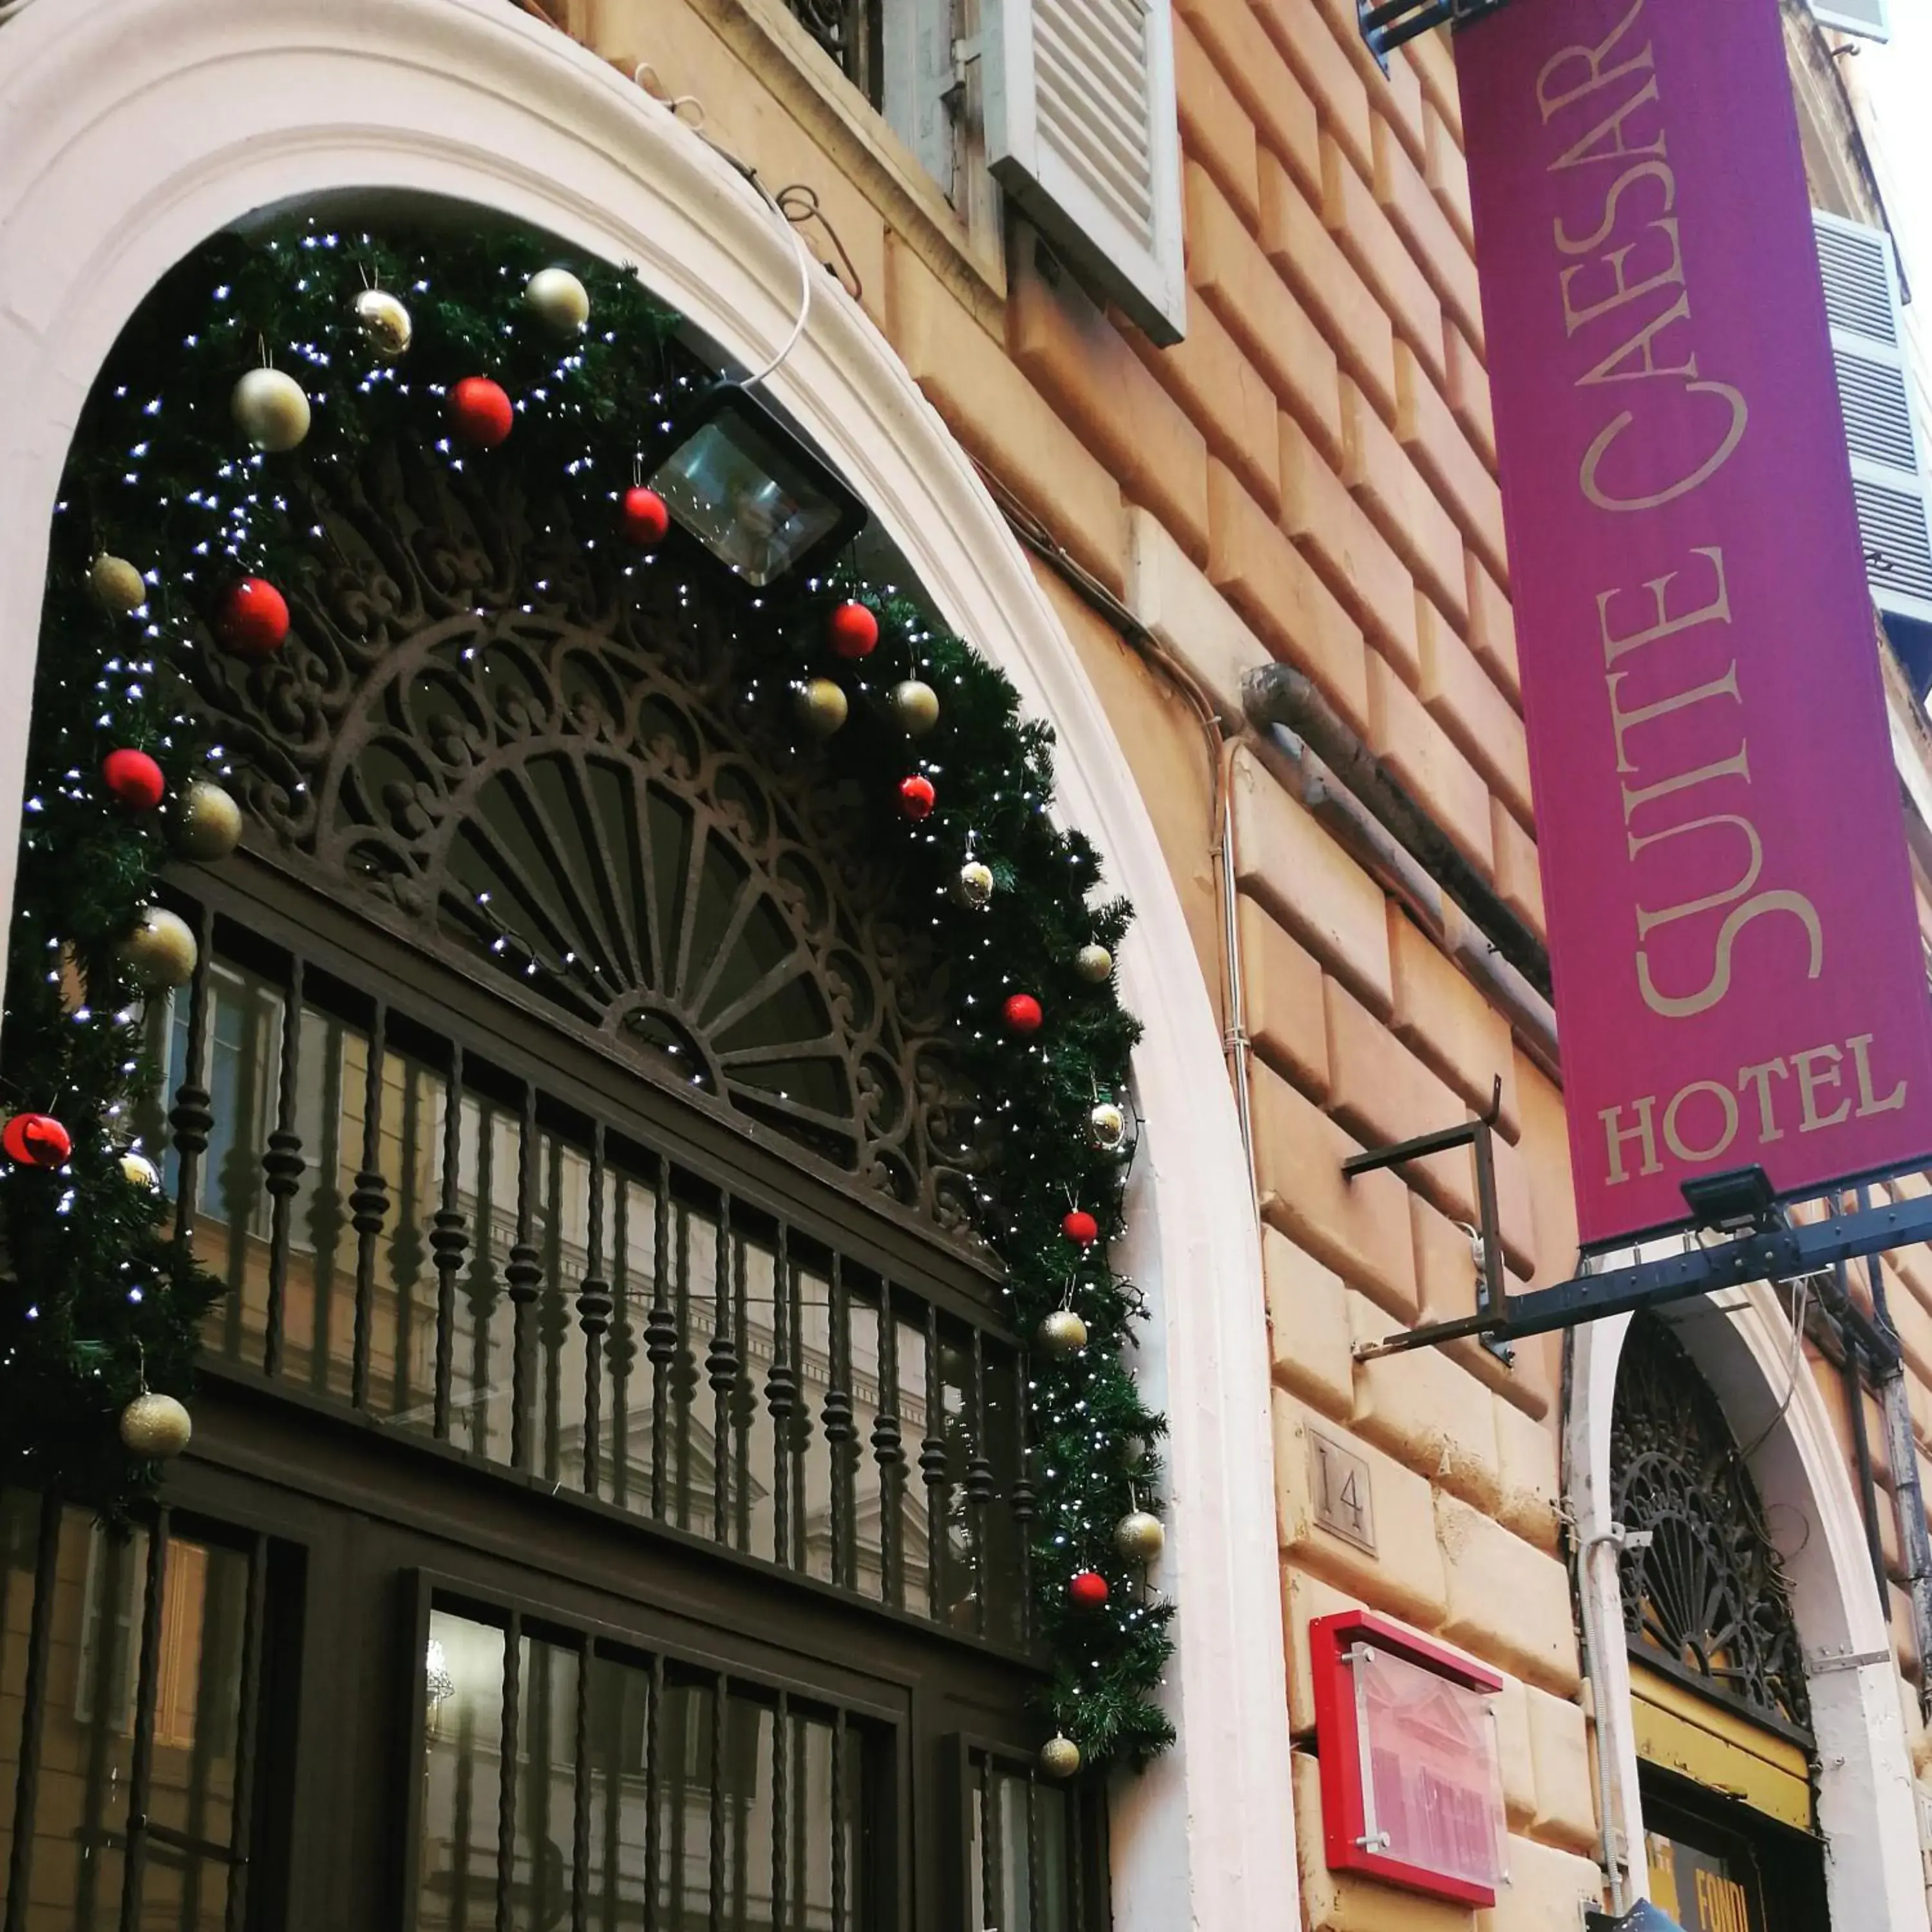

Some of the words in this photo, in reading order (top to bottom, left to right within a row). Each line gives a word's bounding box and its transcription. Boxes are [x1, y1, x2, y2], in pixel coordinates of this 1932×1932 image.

[1537, 0, 1748, 513] CAESAR
[1596, 546, 1823, 1017] SUITE
[1598, 1034, 1908, 1185] HOTEL
[1319, 1446, 1363, 1531] 14
